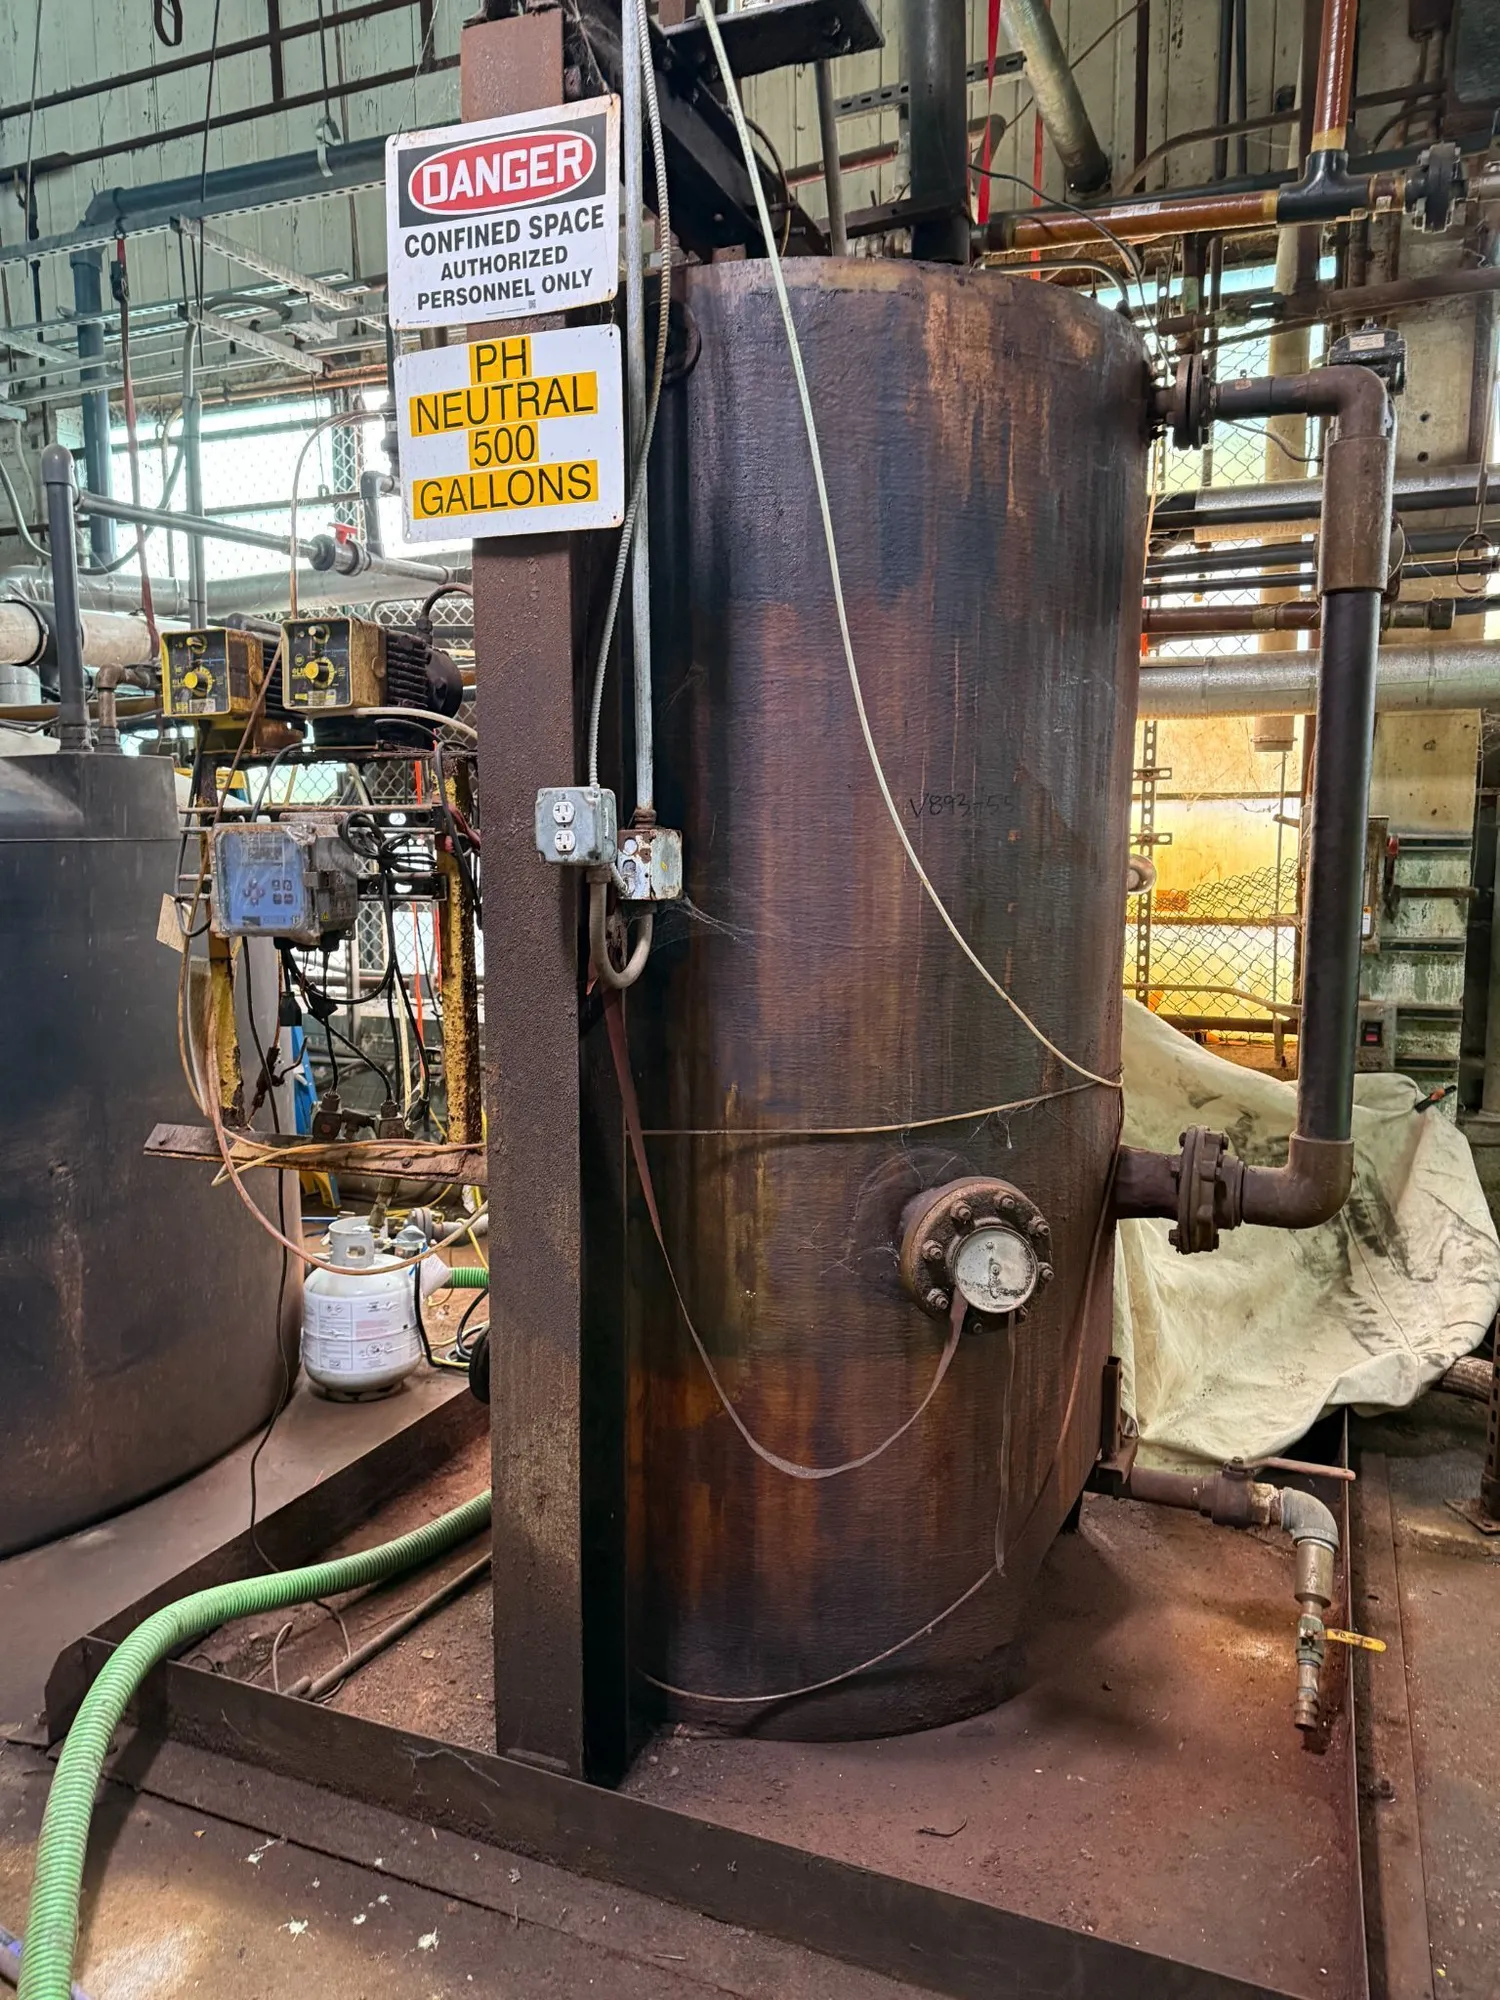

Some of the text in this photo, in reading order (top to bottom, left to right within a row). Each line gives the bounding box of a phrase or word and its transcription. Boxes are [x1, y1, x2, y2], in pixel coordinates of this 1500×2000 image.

[422, 139, 584, 205] DANGER
[405, 204, 604, 258] CONFINED SPACE
[441, 245, 568, 281] AUTHORIZED
[417, 268, 593, 310] PERSONNEL ONLY
[475, 339, 527, 382] PH
[416, 375, 594, 433] NEUTRAL
[473, 424, 535, 467] 500
[420, 463, 592, 516] GALLONS
